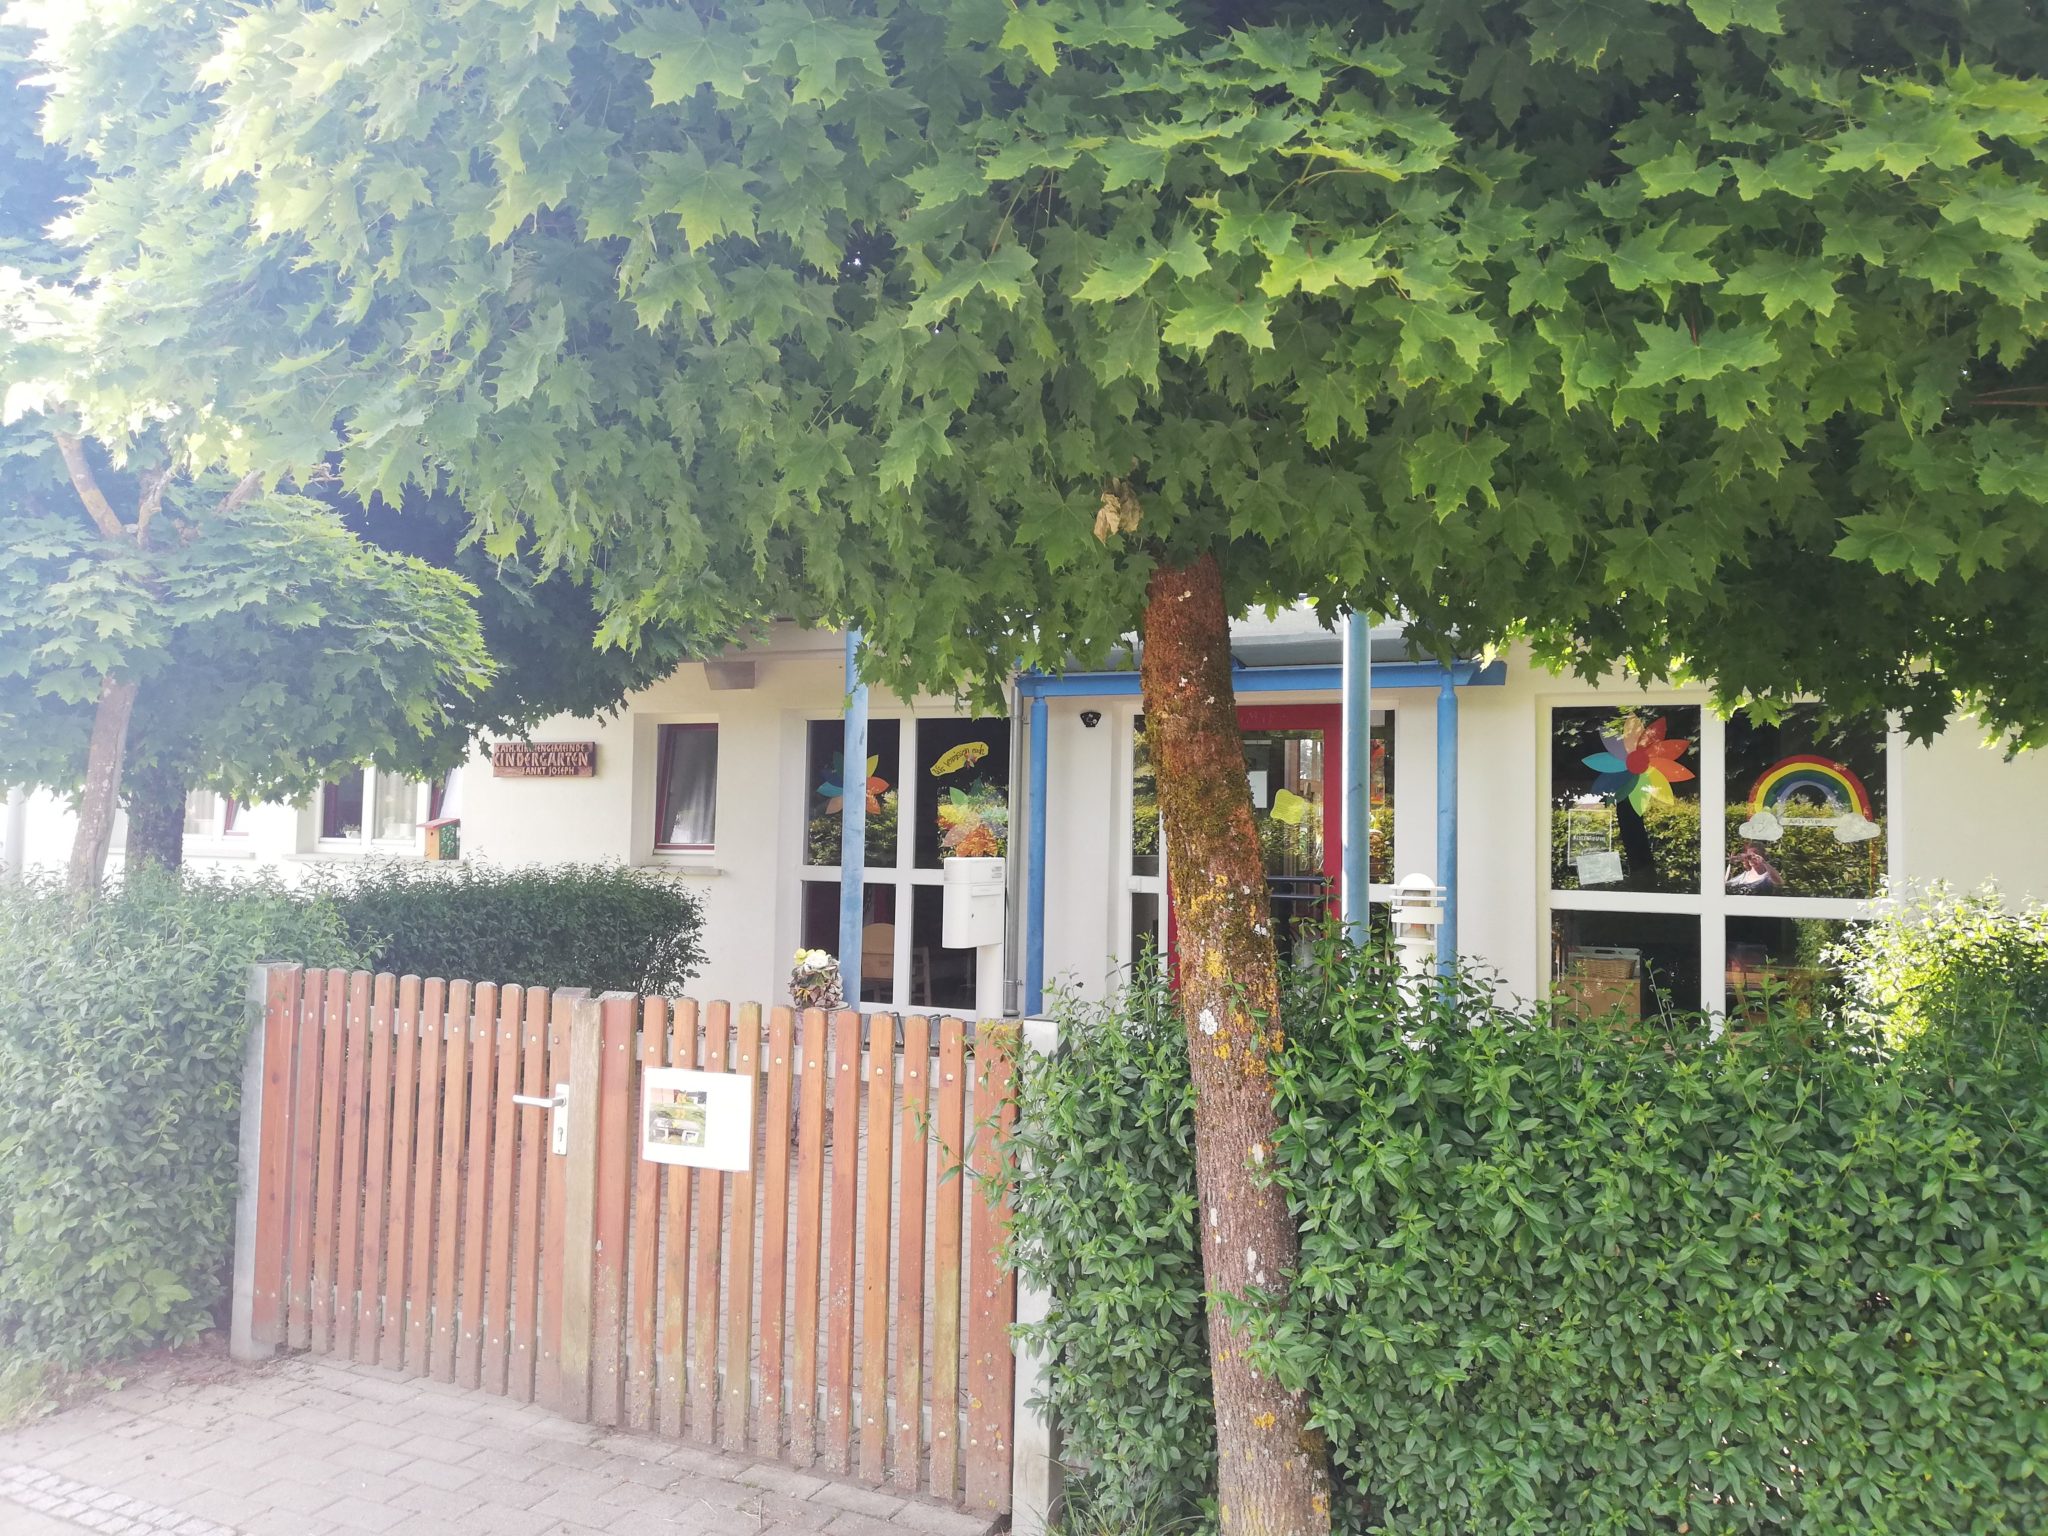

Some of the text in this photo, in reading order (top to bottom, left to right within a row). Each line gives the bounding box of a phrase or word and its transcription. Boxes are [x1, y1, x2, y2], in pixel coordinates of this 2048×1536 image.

[493, 752, 589, 767] KINDERGARTEN
[522, 766, 575, 777] SANKT JOSEPH
